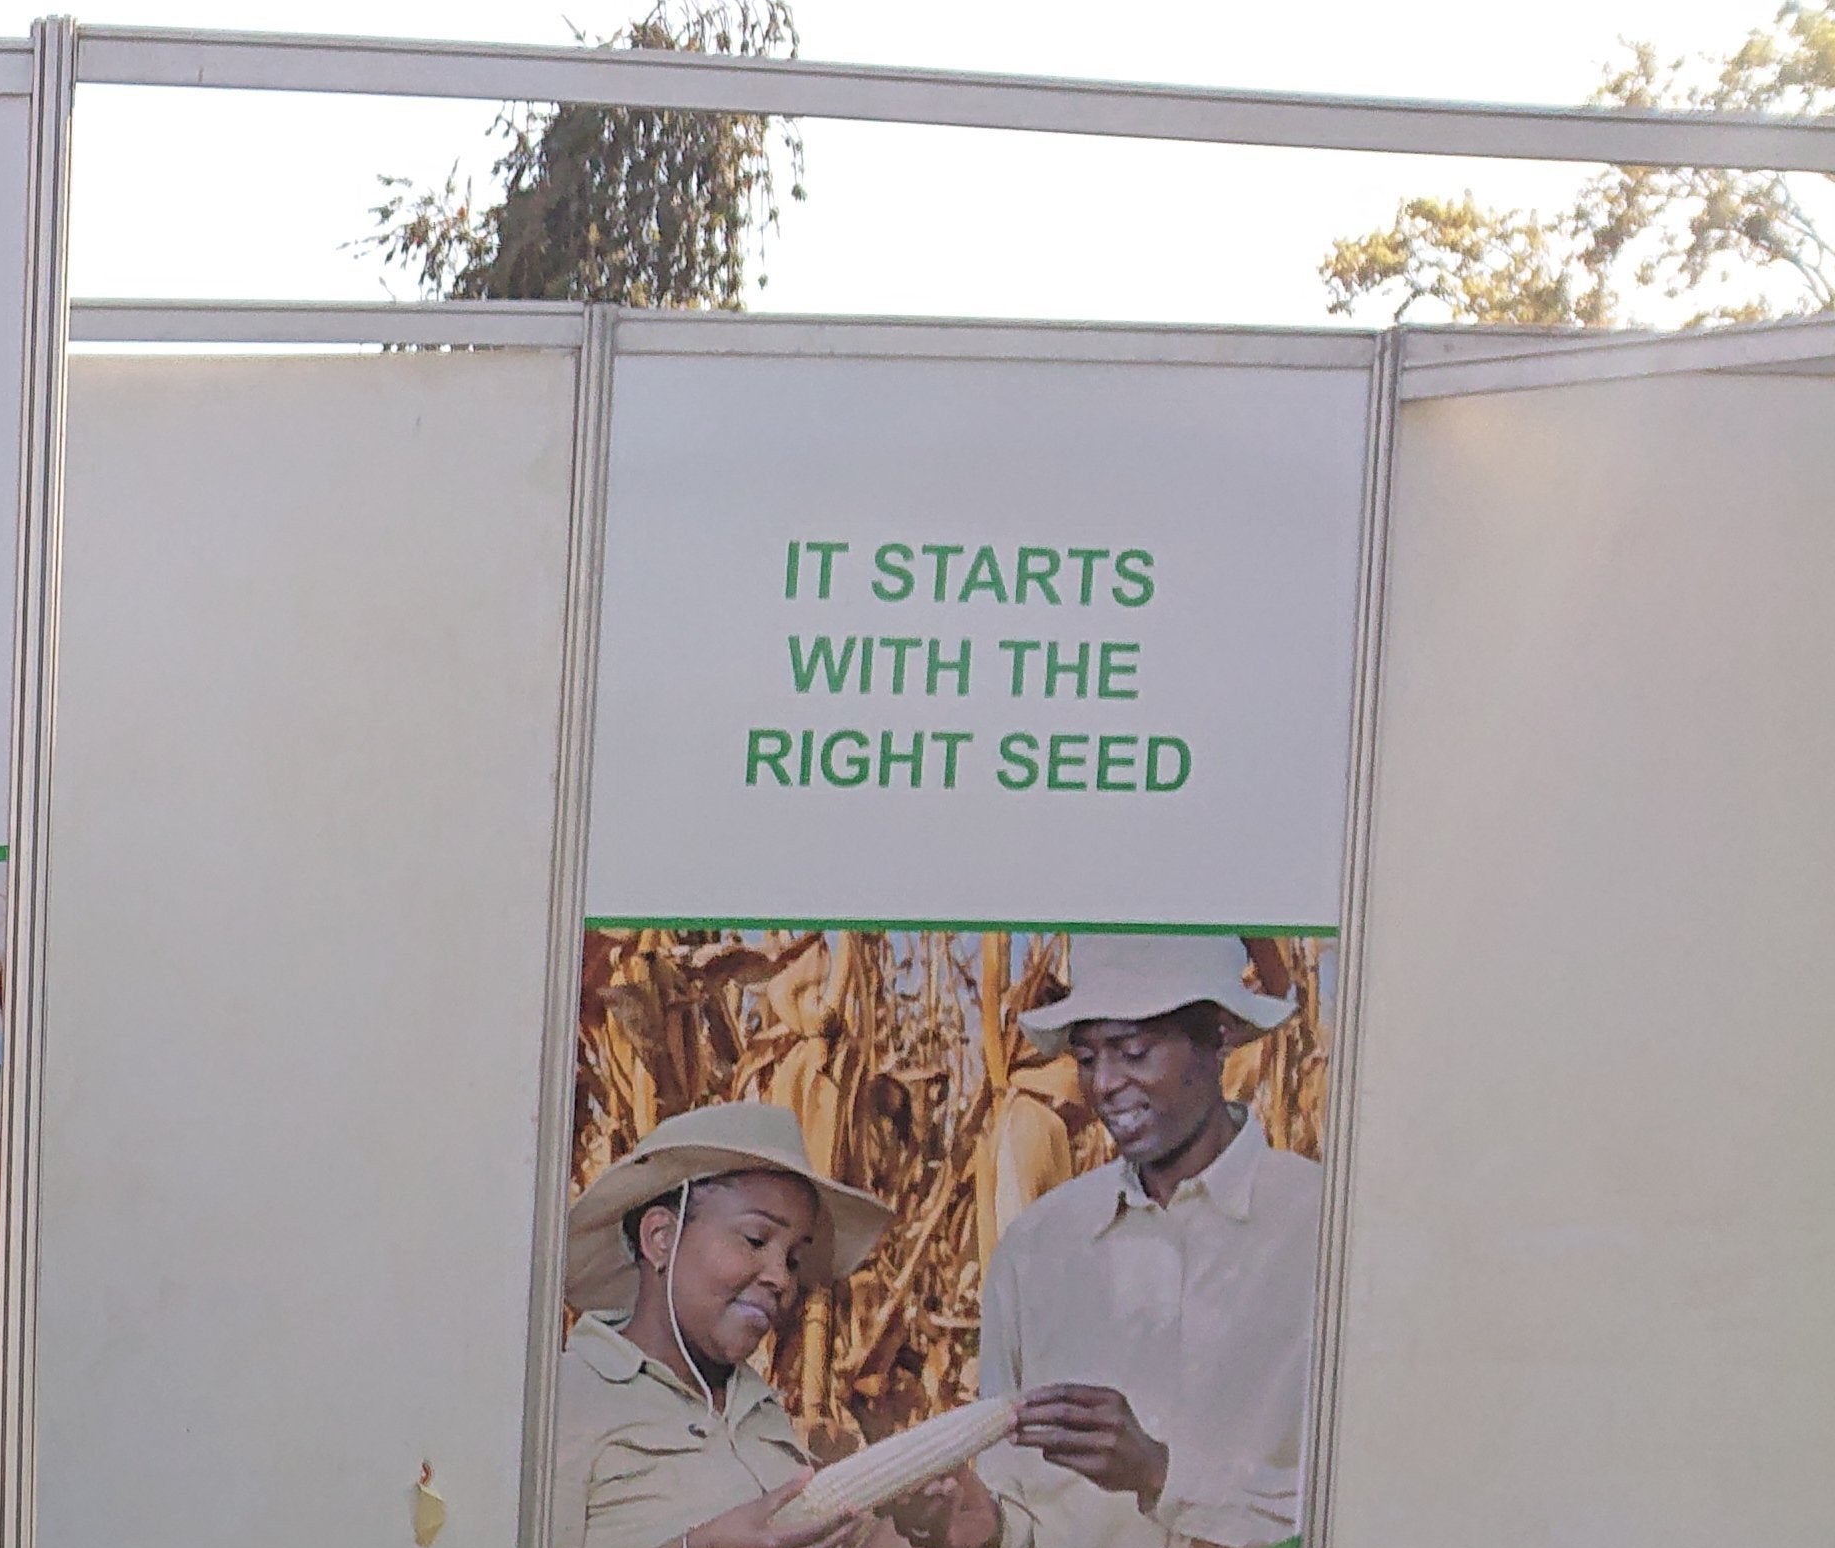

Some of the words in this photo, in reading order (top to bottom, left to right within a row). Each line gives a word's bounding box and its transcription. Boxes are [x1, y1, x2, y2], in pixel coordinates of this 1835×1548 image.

[785, 542, 848, 597] IT
[874, 543, 1153, 606] STARTS
[789, 636, 970, 695] WITH
[1002, 640, 1139, 698] THE
[747, 729, 972, 787] RIGHT
[997, 733, 1190, 792] SEED
